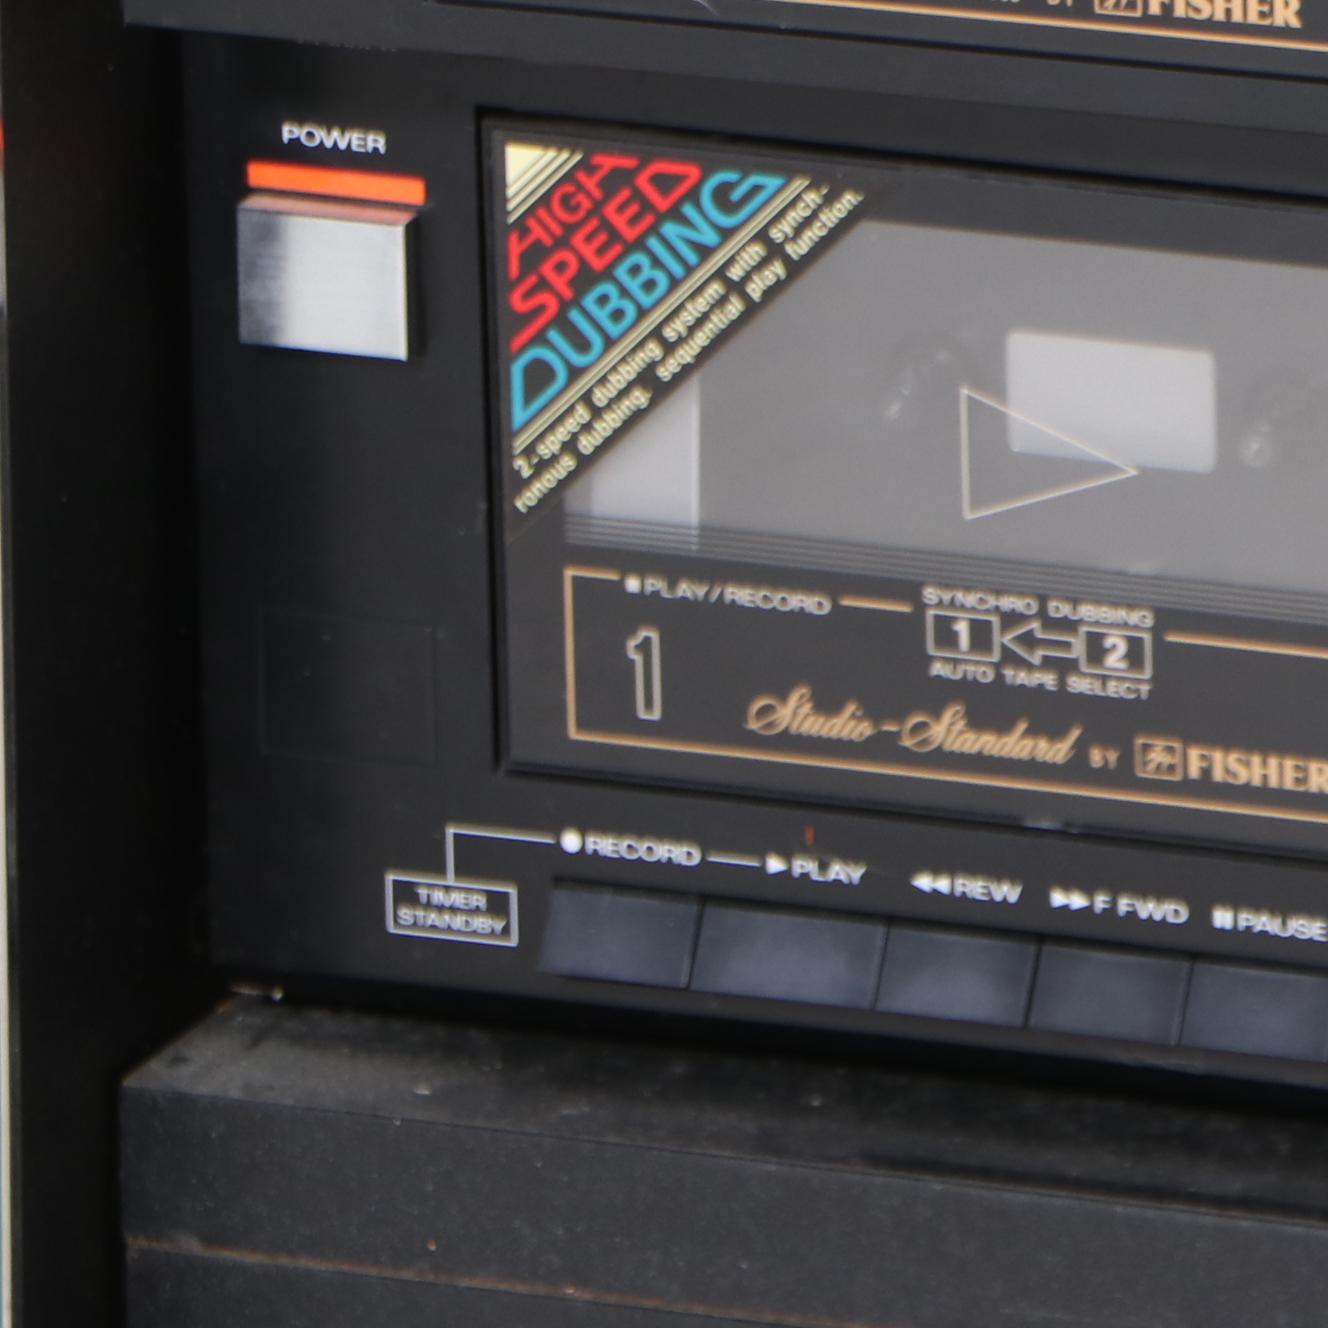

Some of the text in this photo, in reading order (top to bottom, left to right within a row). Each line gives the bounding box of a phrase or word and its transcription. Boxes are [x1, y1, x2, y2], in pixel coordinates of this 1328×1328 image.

[281, 123, 386, 153] POWER
[507, 153, 640, 279] HIGH
[510, 161, 702, 353] SPEED
[511, 169, 787, 432] DUBBING
[513, 242, 767, 479] 2-speed dubbing system with
[644, 577, 832, 615] PLAY/RECORD
[922, 586, 1154, 629] SYNCHRO DUBBING
[585, 834, 701, 867] RECORD
[791, 856, 867, 886] PLAY
[953, 878, 1023, 905] REW
[1237, 909, 1328, 942] PAUSE
